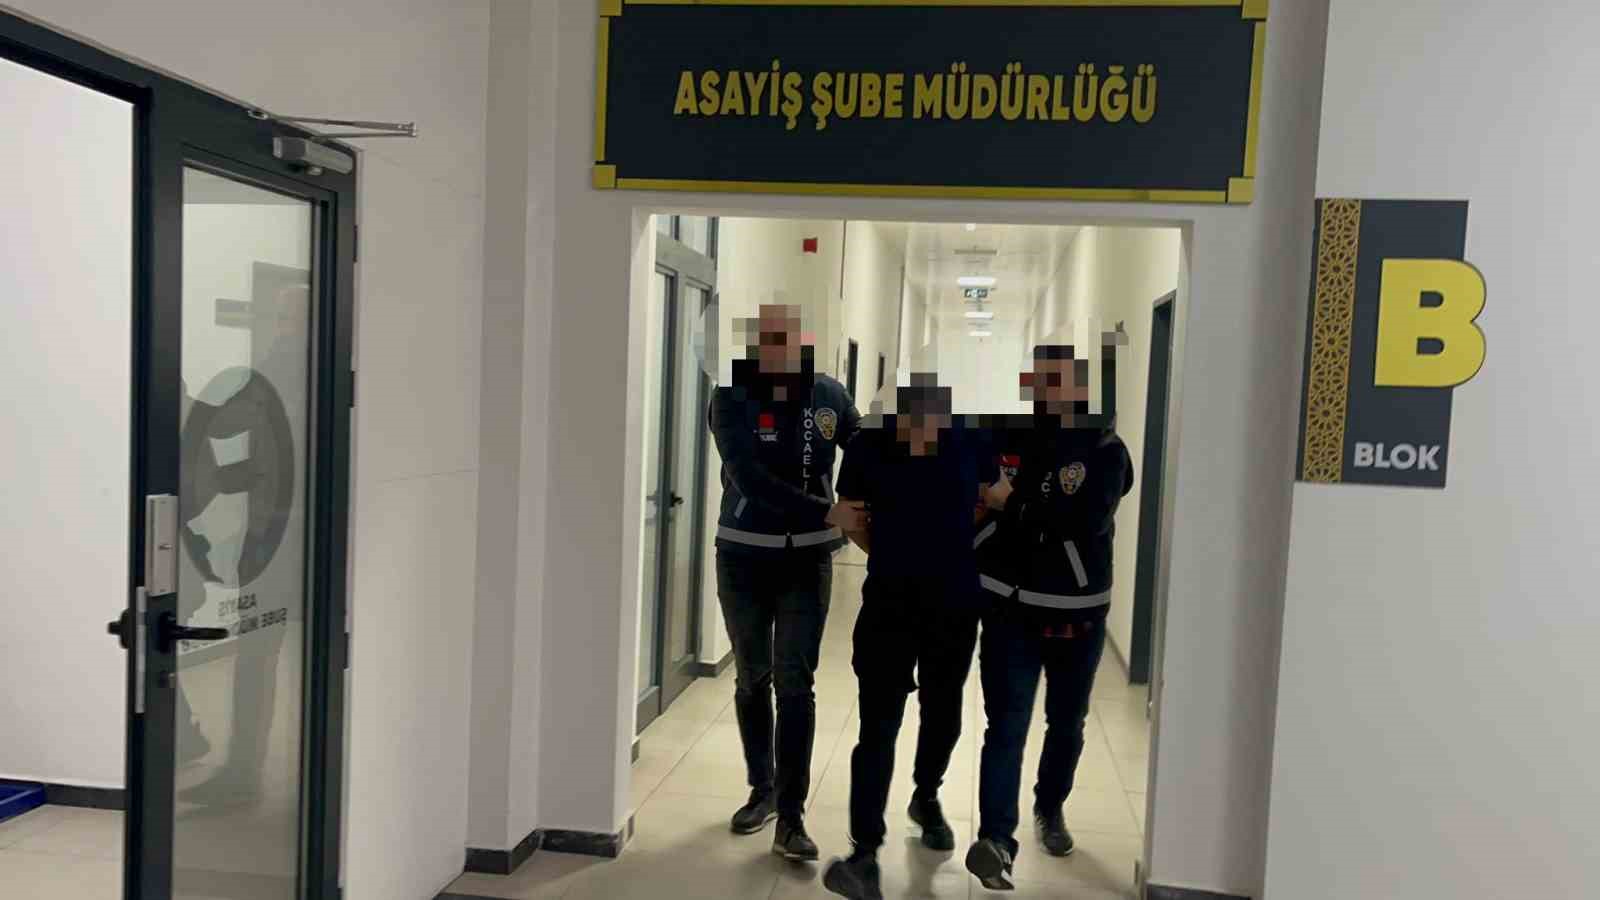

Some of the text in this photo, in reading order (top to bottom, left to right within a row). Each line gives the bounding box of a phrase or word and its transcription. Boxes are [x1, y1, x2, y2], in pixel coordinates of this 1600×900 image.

[673, 58, 1157, 131] ASAYİŞ ŞUBE MÜDÜRLÜĞÜ
[1374, 258, 1487, 388] B
[1353, 442, 1441, 471] BLOK
